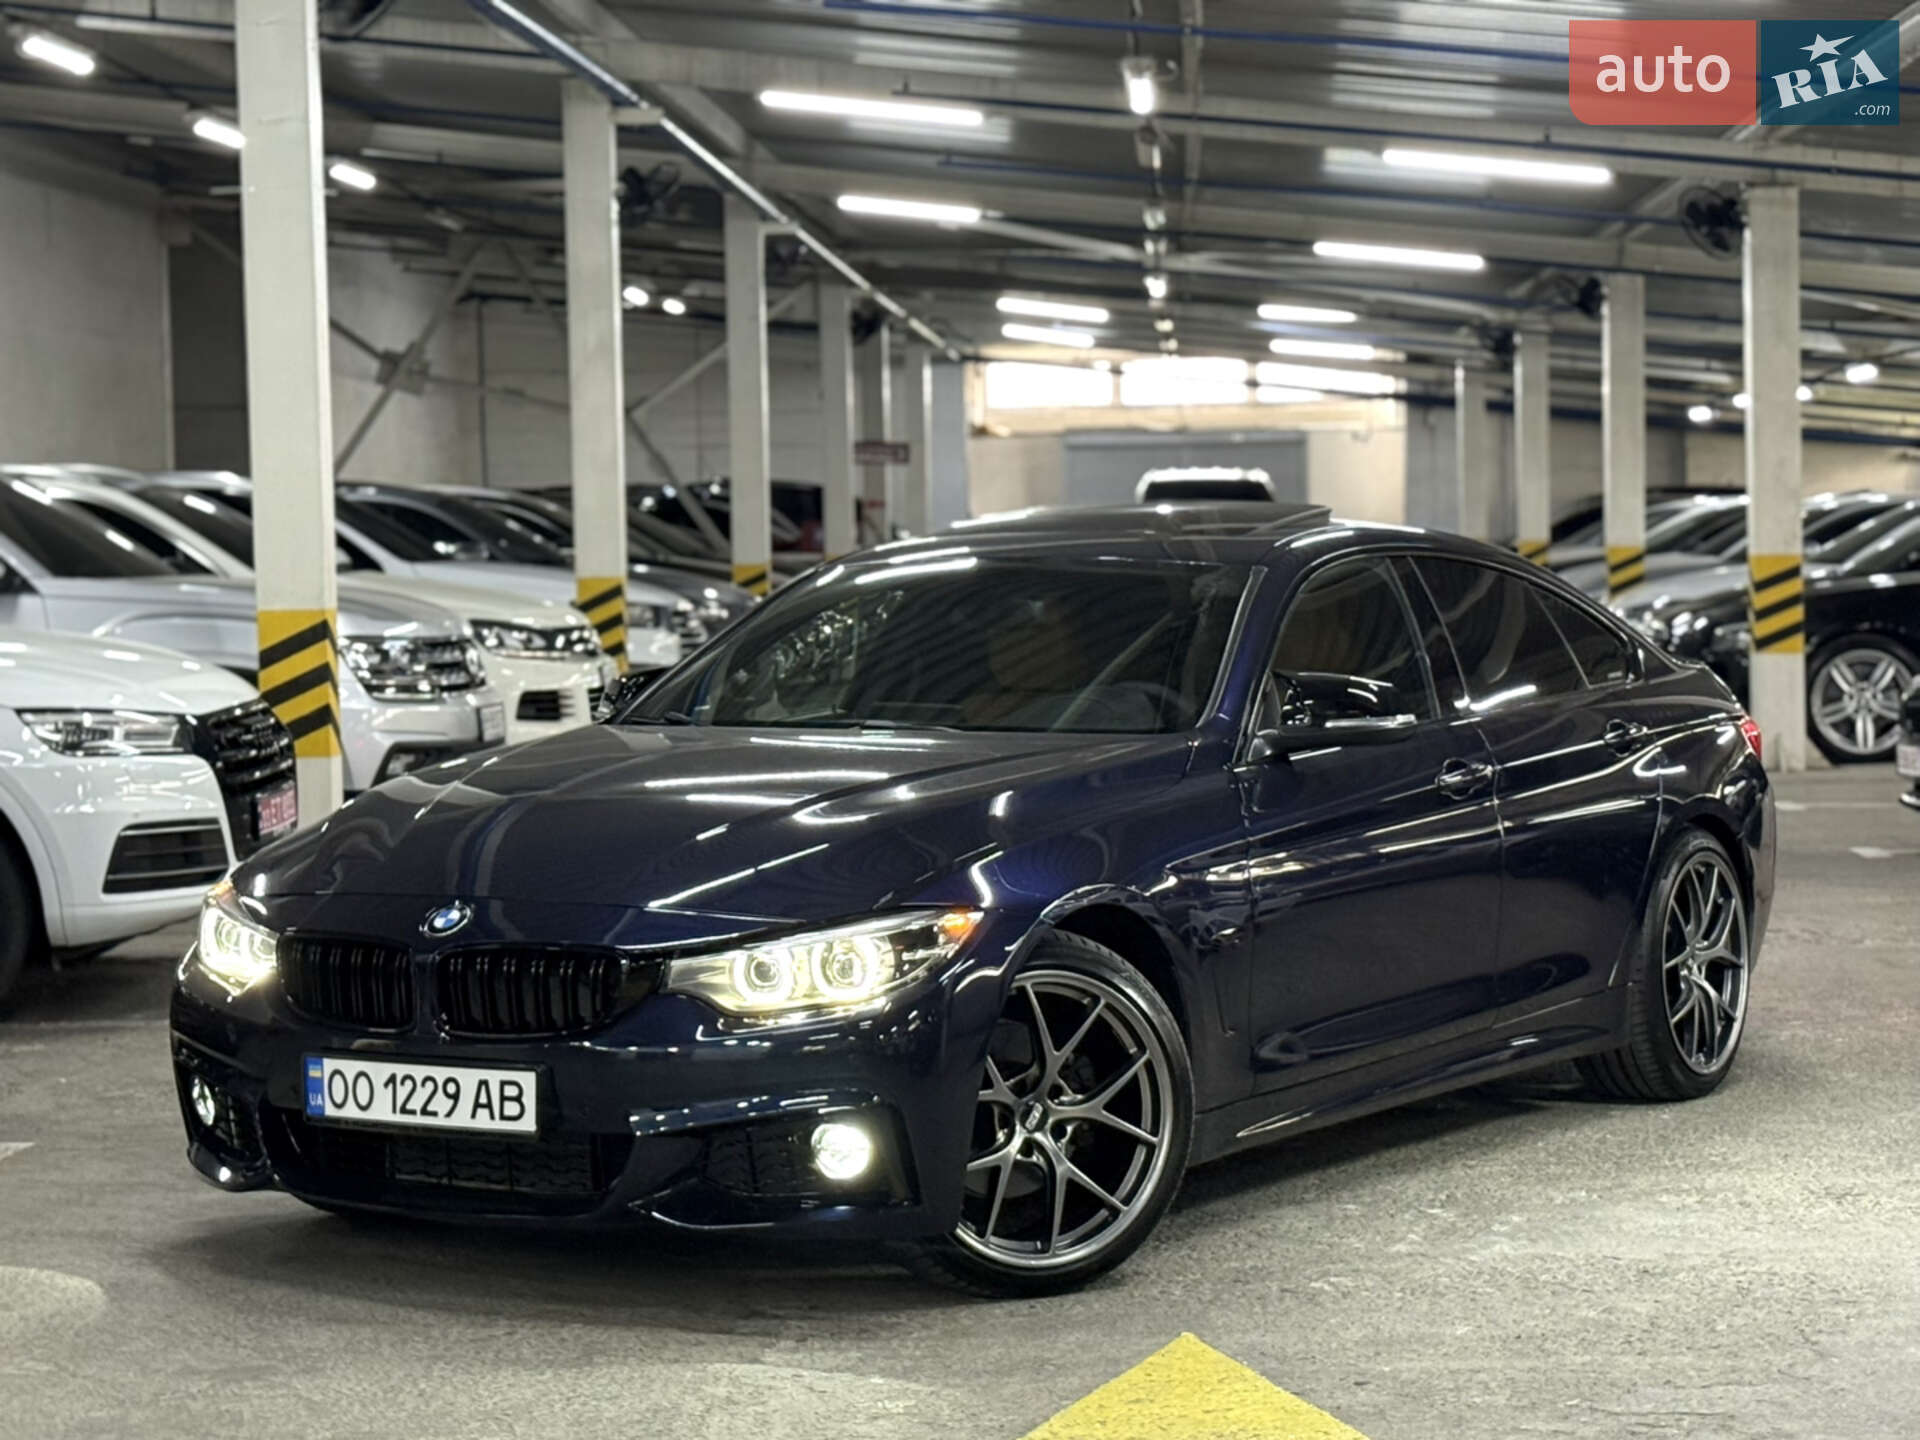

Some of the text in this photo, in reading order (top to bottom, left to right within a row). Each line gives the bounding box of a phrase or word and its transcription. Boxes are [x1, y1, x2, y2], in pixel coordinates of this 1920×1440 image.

[309, 1093, 324, 1107] UA
[383, 1072, 461, 1118] 1229
[470, 1078, 526, 1121] AB
